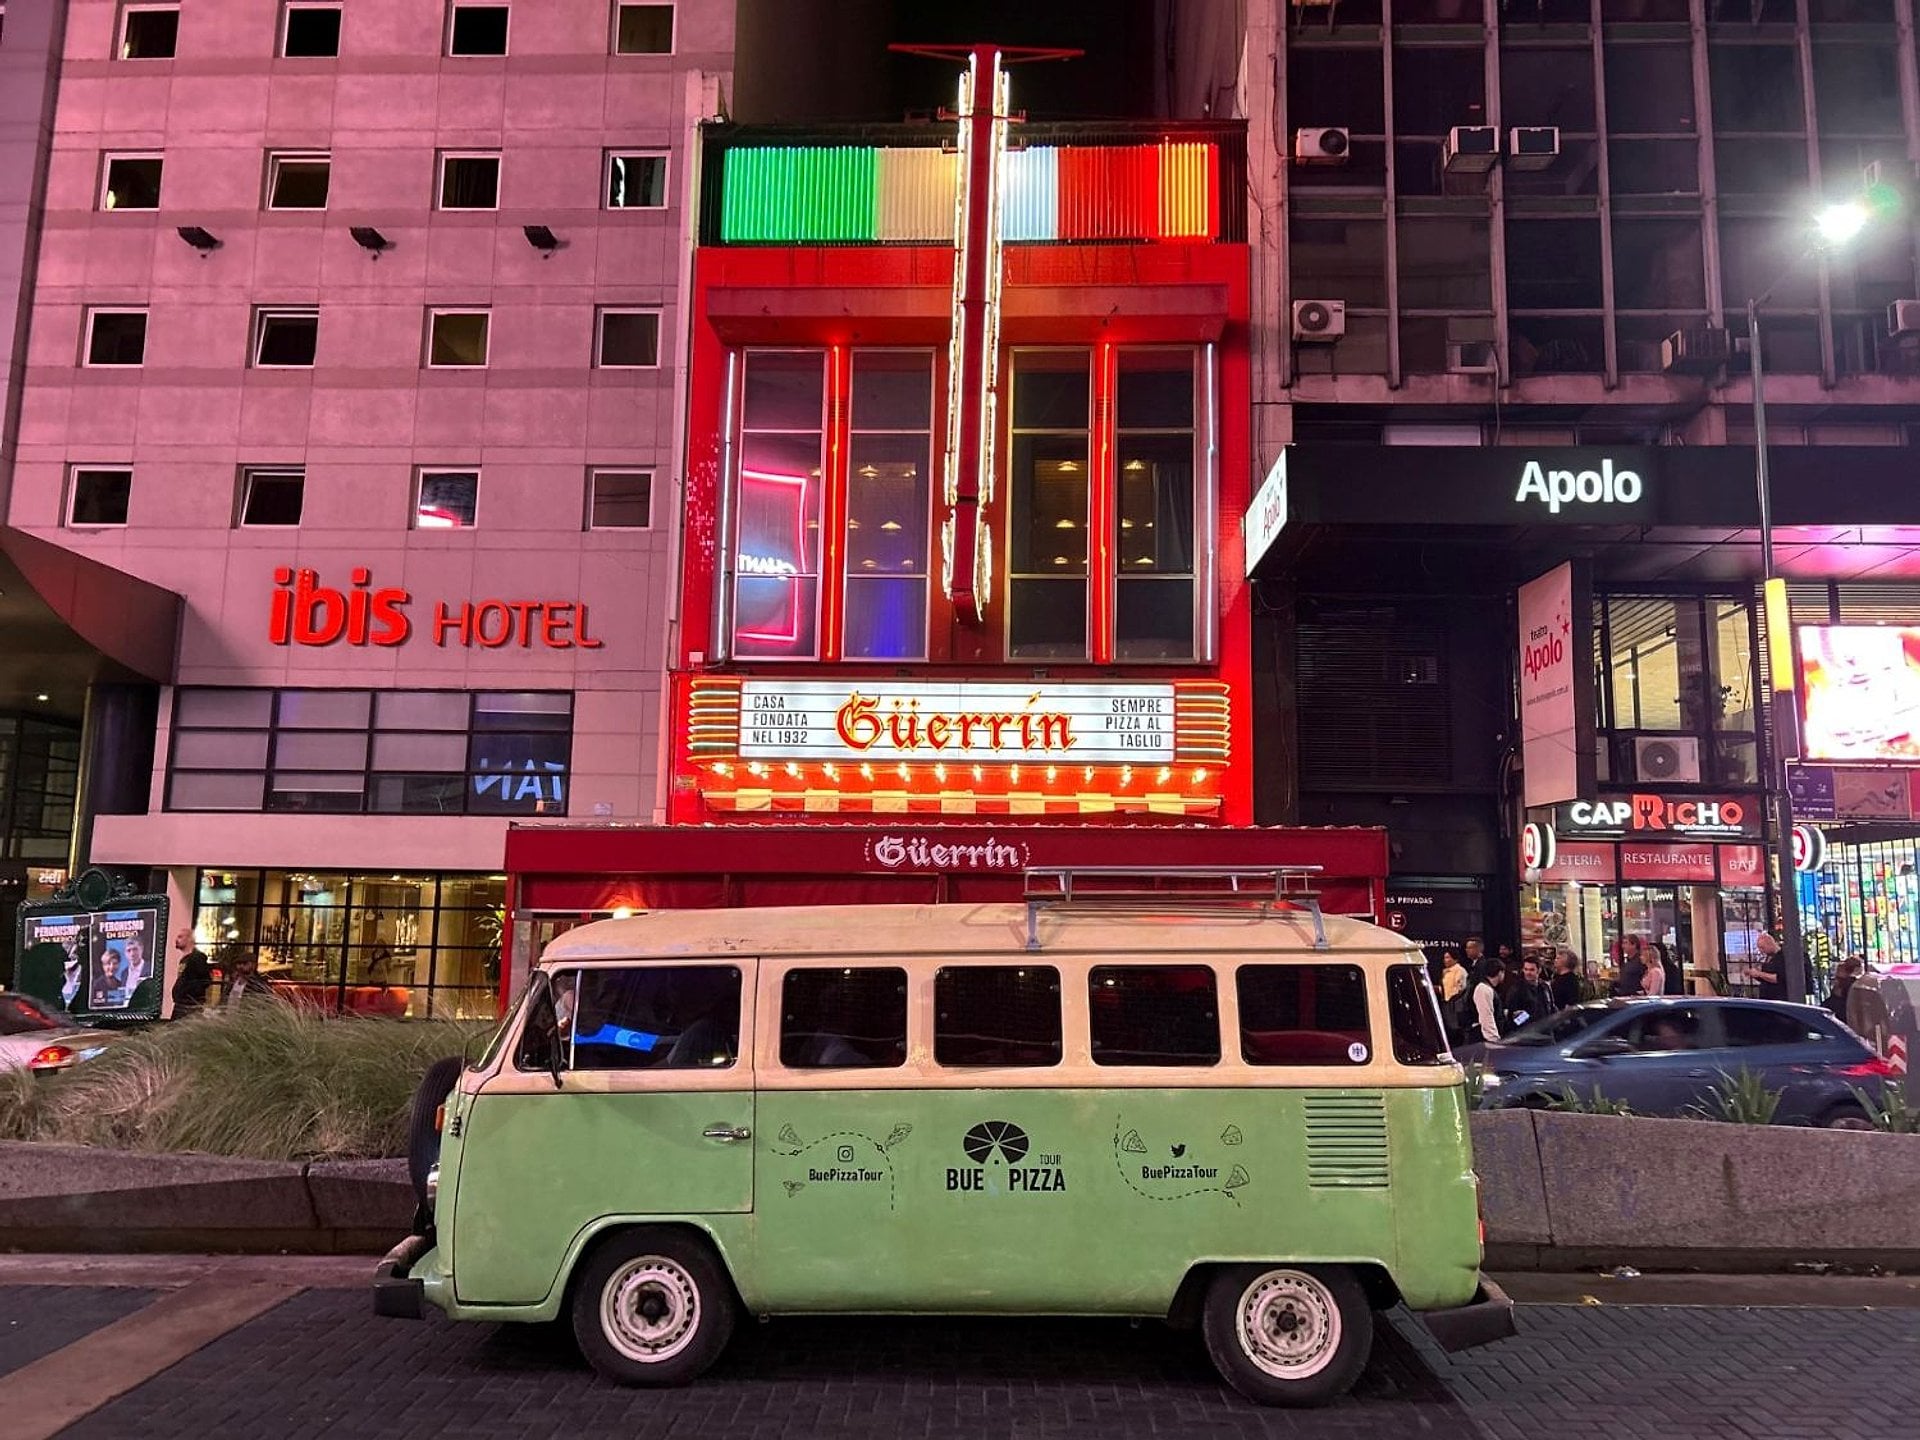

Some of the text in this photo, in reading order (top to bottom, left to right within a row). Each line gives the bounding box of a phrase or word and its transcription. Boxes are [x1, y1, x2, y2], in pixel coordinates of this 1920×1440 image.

[1515, 458, 1642, 514] Apolo
[269, 567, 603, 648] ibis HOTEL
[1524, 632, 1563, 681] Apolo
[753, 695, 785, 709] CASA
[1112, 699, 1162, 713] SEMPRE
[752, 713, 808, 727] FONDATA
[1106, 716, 1161, 730] PIZZA AL
[752, 730, 808, 744] NEL 1932
[1120, 733, 1161, 748] TAGLIO
[1570, 793, 1744, 830] CAPRICHO
[1556, 854, 1602, 866] ETERIA
[1624, 852, 1712, 865] RESTAURANTE
[1729, 860, 1757, 871] BAR
[1384, 896, 1433, 905] AS PRIVADAS
[100, 920, 144, 933] PERONISMO
[1039, 1154, 1062, 1166] TOUR
[808, 1167, 883, 1181] BuePizzaTour
[1142, 1164, 1219, 1179] BuePizzaTour
[946, 1167, 1066, 1191] BUE PIZZA
